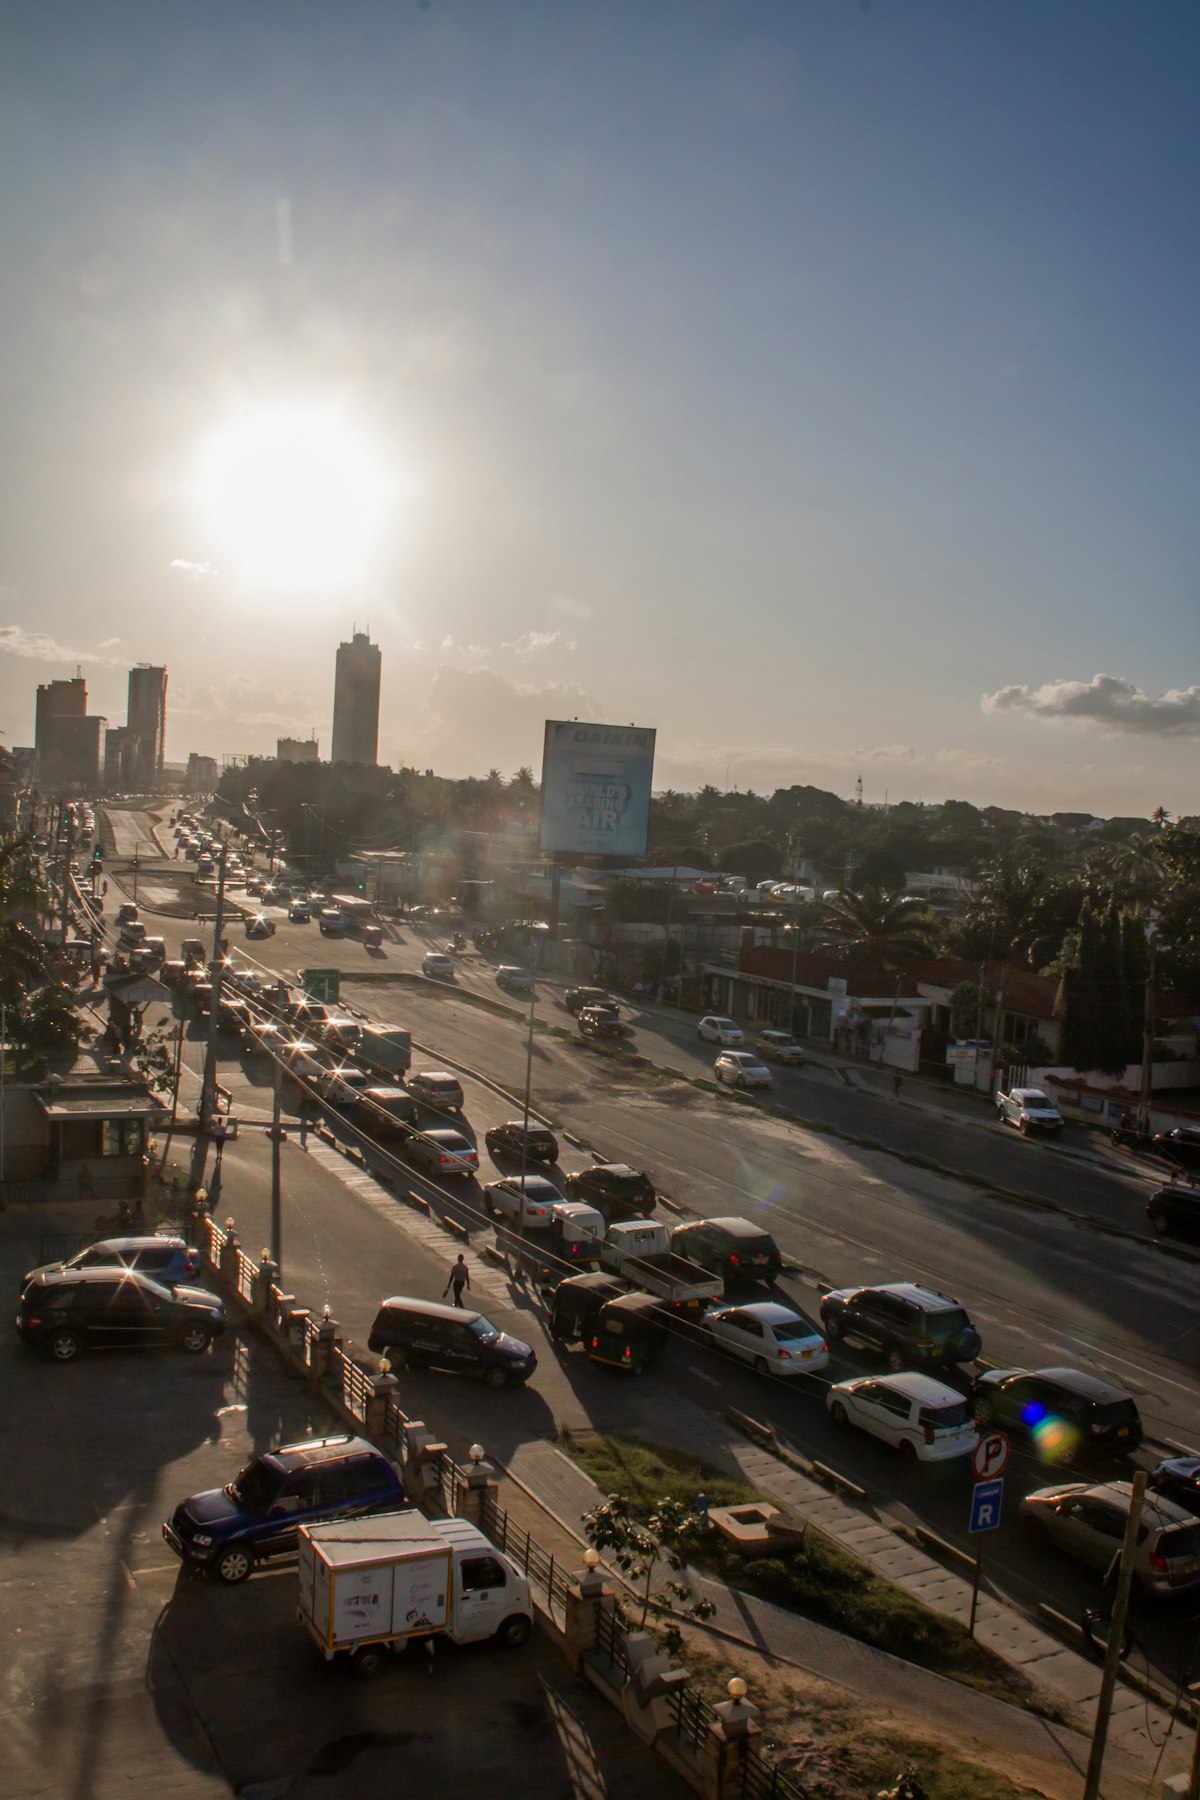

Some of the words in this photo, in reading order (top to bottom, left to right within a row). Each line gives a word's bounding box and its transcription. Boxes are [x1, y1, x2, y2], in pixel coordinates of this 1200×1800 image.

[573, 729, 648, 748] DAIKIN
[567, 782, 627, 798] WORLD'S
[569, 796, 624, 810] LEADING
[578, 809, 618, 829] AIR
[985, 1439, 1002, 1472] P
[978, 1504, 993, 1526] R
